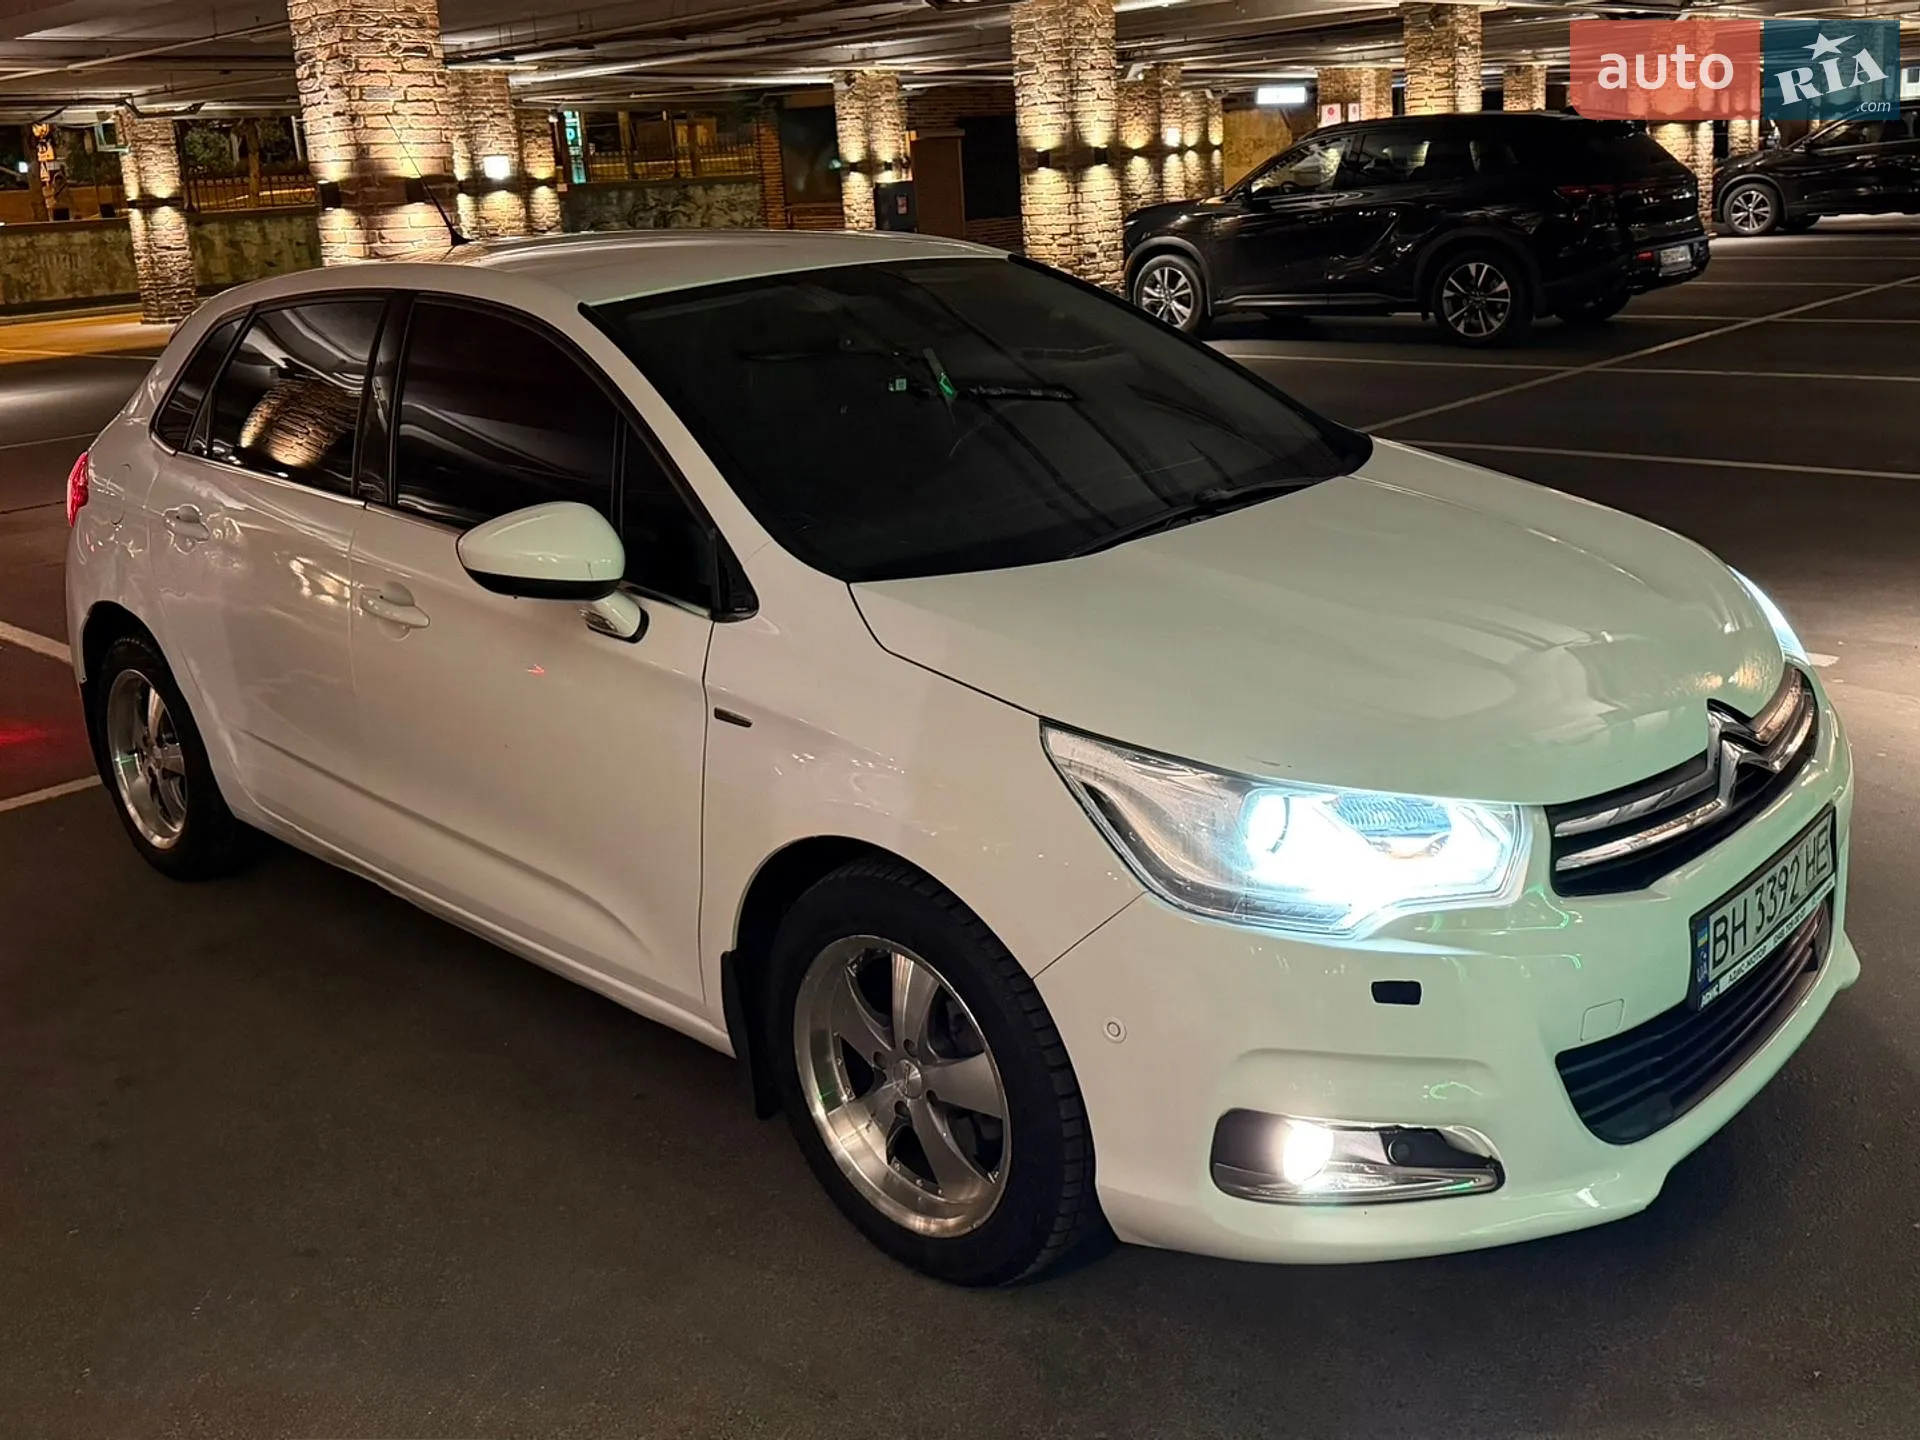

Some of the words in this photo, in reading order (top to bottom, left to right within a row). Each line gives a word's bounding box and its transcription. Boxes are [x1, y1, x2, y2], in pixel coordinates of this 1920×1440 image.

[1712, 898, 1748, 970] BH
[1754, 854, 1800, 935] 3392
[1805, 824, 1829, 887] HE
